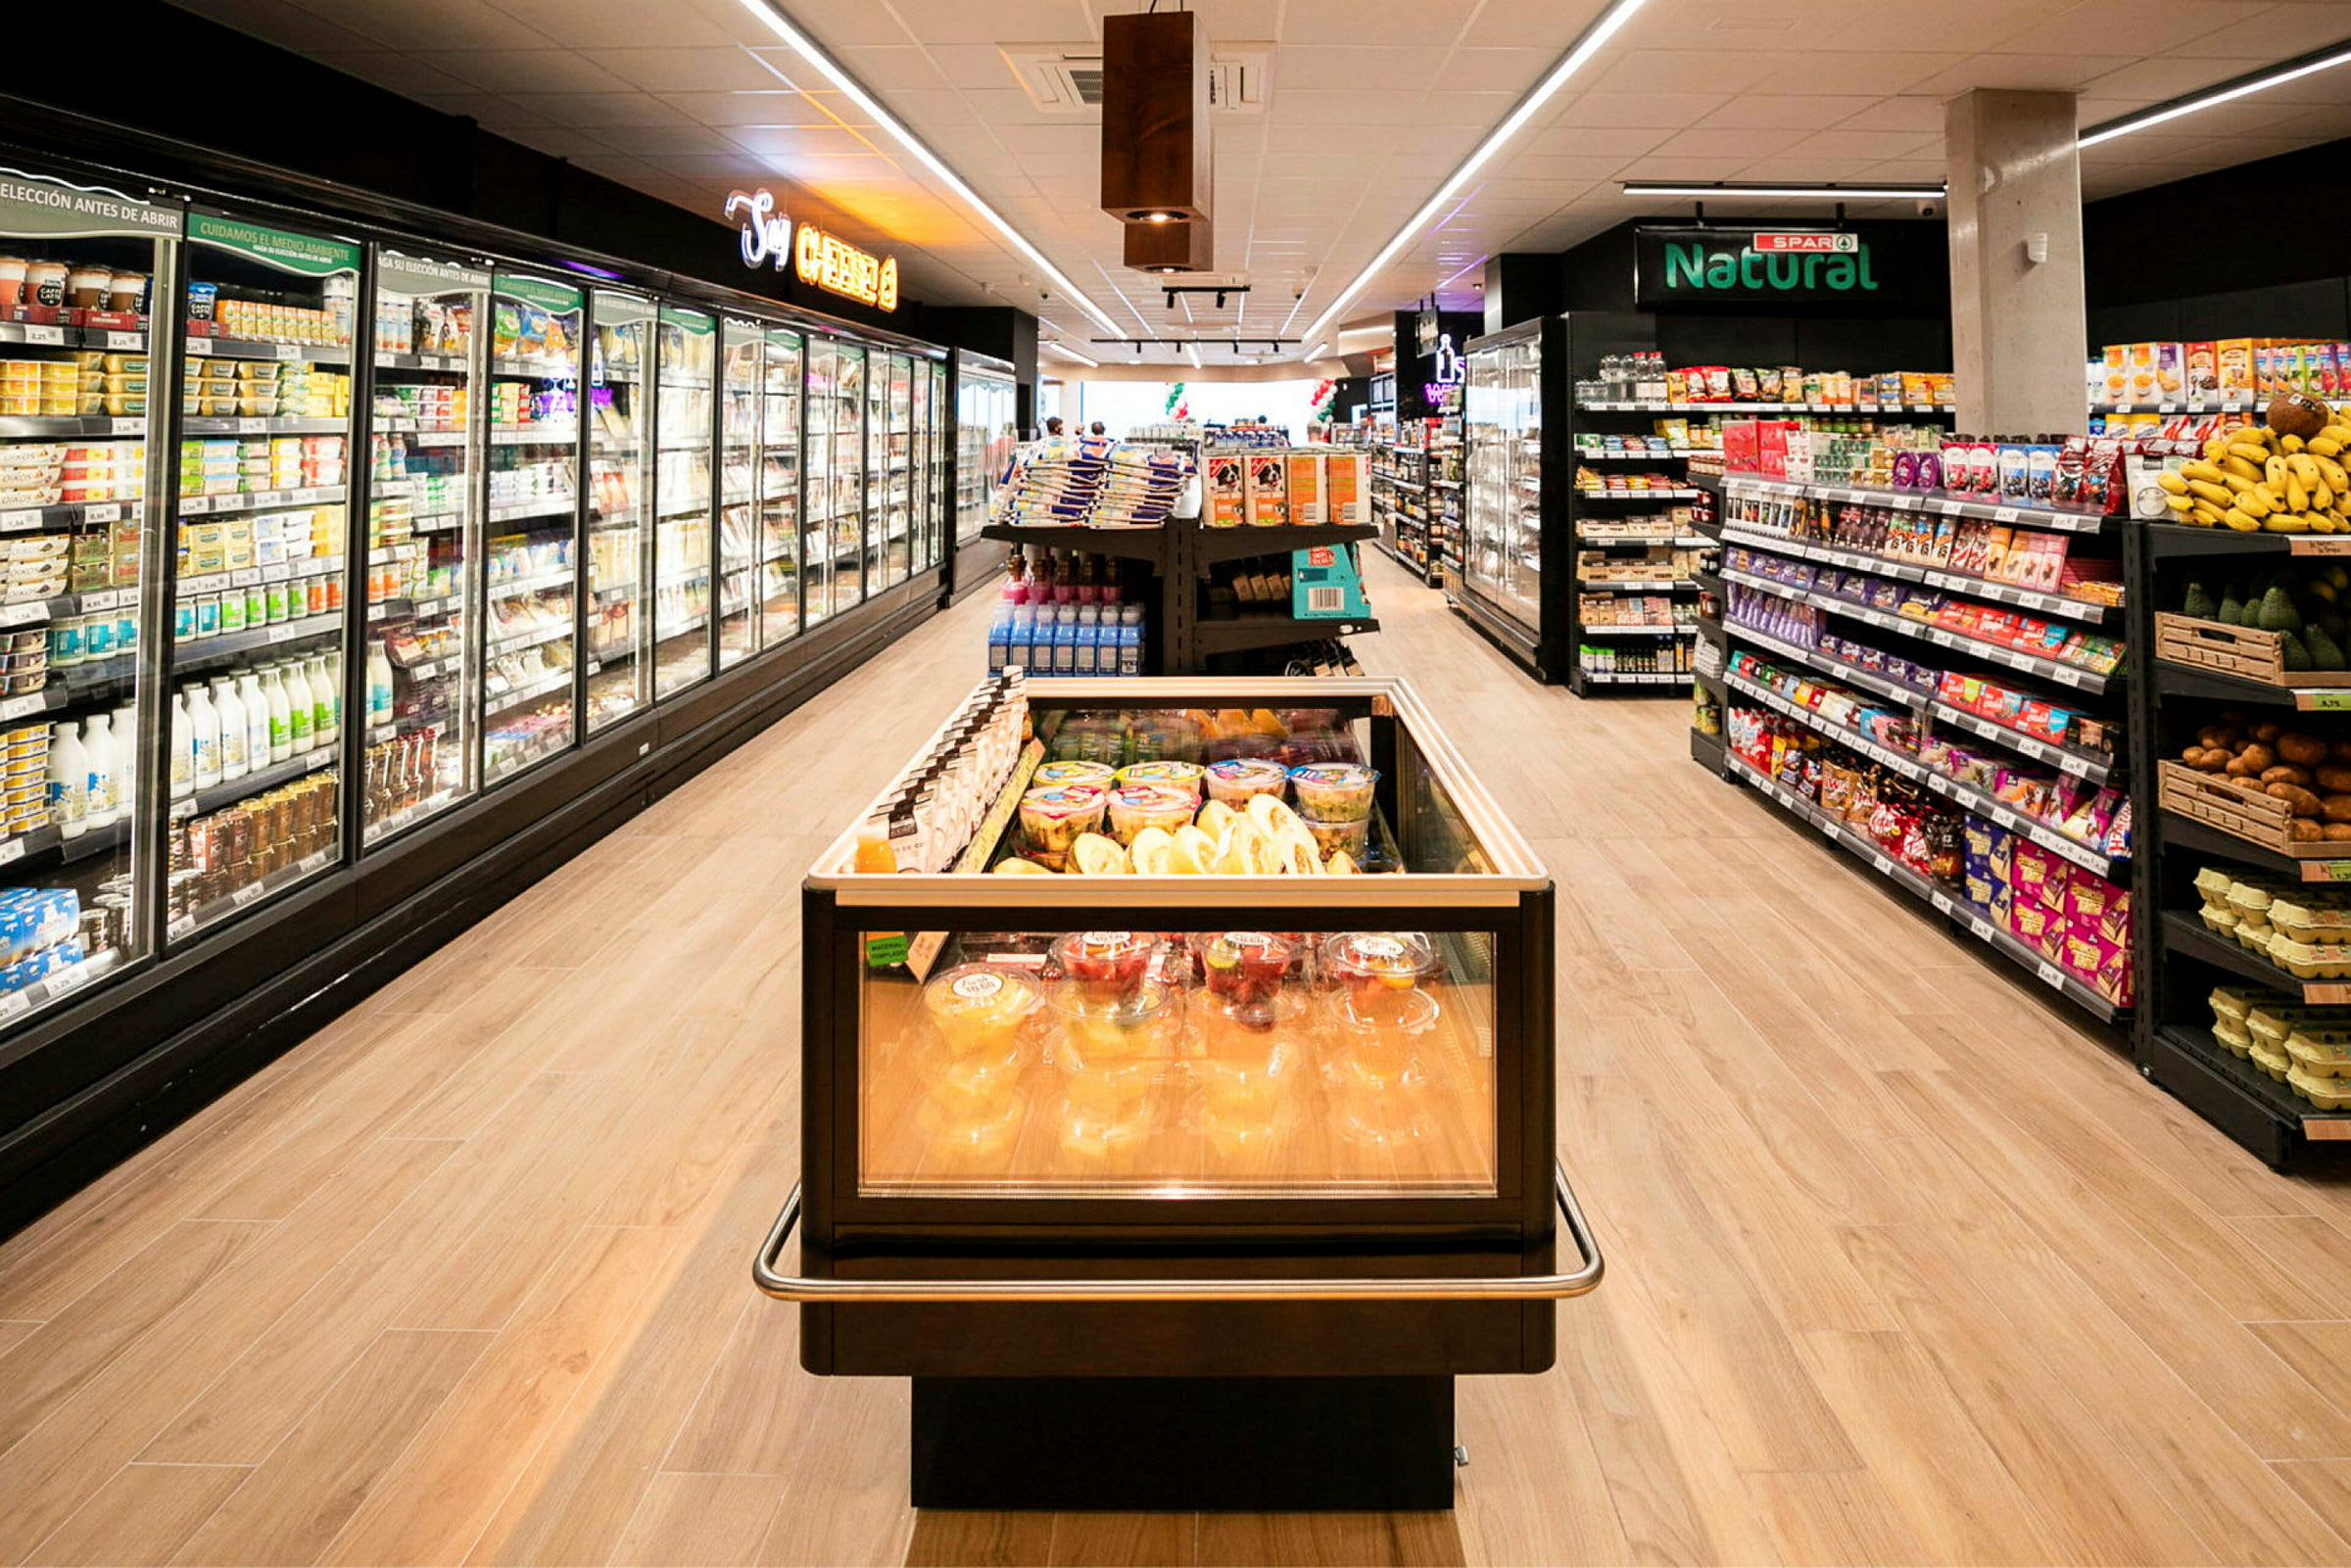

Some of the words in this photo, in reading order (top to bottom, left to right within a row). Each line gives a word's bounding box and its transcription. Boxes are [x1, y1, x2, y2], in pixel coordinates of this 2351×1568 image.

[0, 182, 72, 209] ELECCIÓN
[73, 198, 119, 217] ANTES
[120, 206, 138, 221] DE
[140, 211, 178, 229] ABRIR
[200, 221, 258, 244] CUIDAMOS
[259, 233, 270, 246] EL
[271, 235, 304, 252] MEDIO
[306, 243, 351, 261] AMBIENTE
[1773, 236, 1833, 249] SPAR
[395, 258, 405, 271] SU
[1666, 243, 1879, 290] Natural
